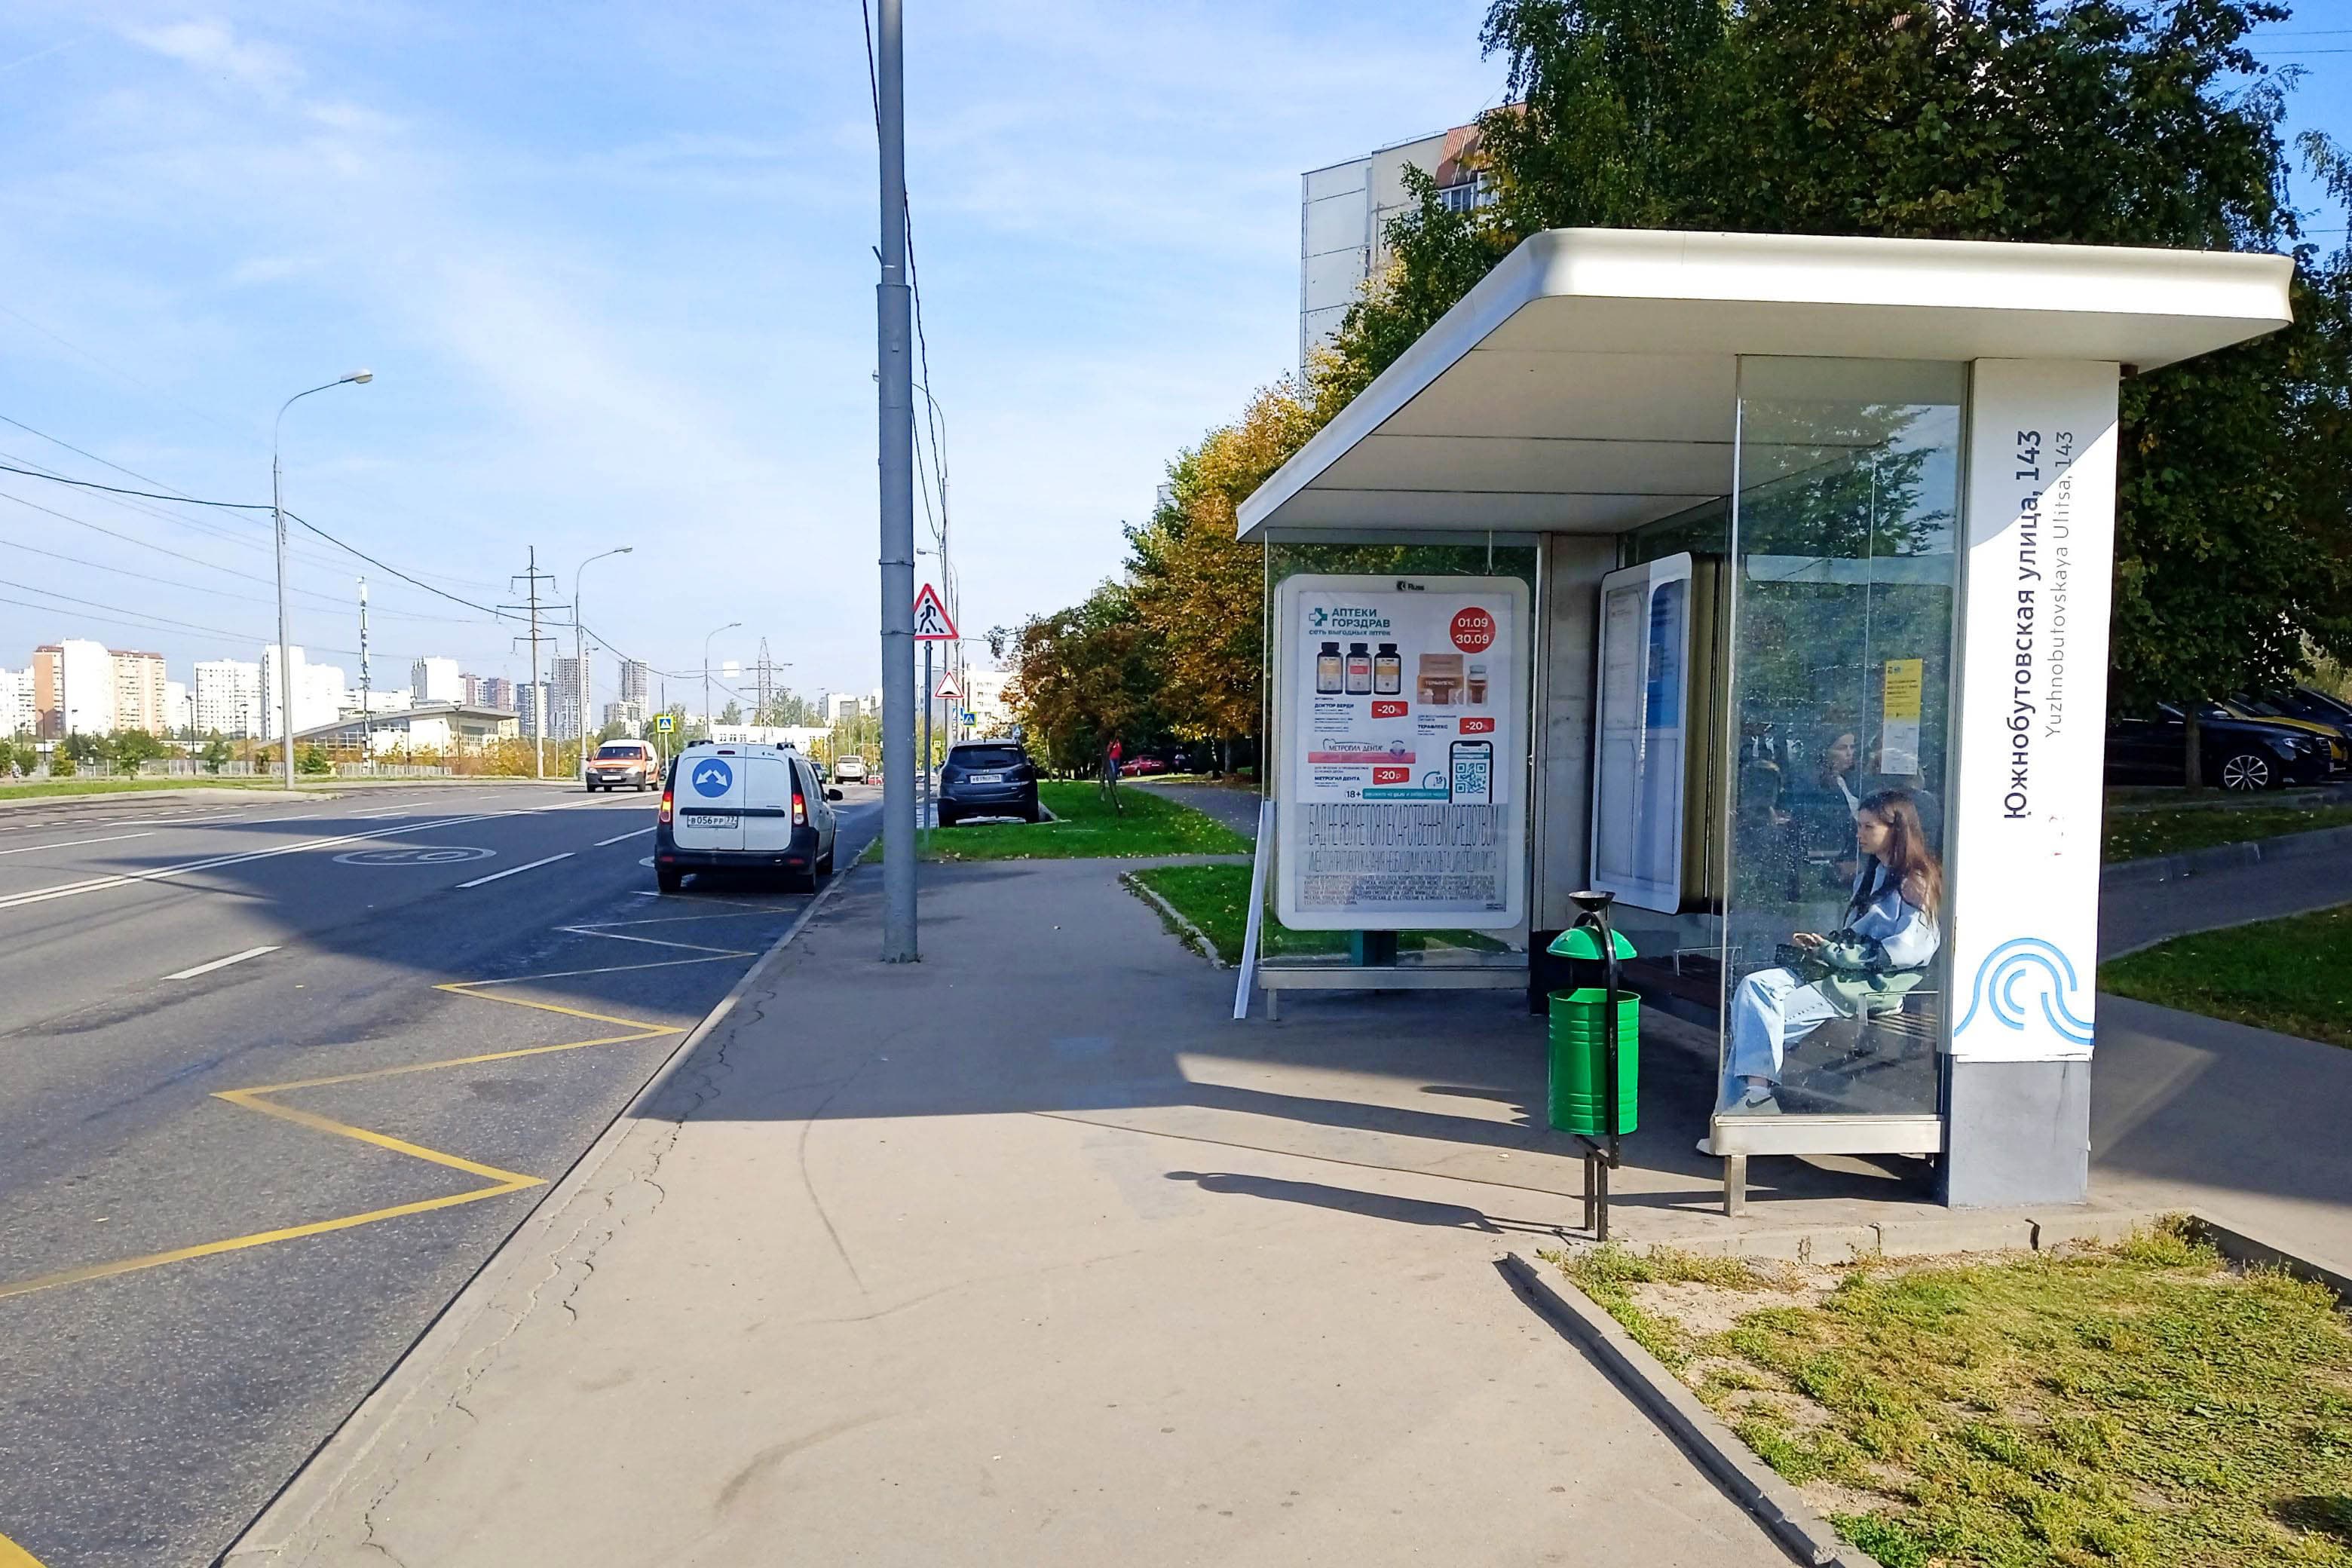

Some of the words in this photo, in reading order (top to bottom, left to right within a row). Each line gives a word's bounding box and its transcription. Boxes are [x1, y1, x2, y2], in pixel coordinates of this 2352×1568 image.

[2016, 430, 2041, 481] 143
[2055, 432, 2073, 467] 143
[2052, 476, 2072, 538] Ulitsa,
[2018, 491, 2043, 581] улица,
[1331, 608, 1377, 617] АПТЕКИ
[1331, 619, 1391, 629] ГОРЗДРАВ
[1457, 617, 1489, 627] 01.09
[1455, 635, 1490, 644] 30.09
[2044, 547, 2072, 737] Yuzhnobutovskaya
[2004, 590, 2036, 818] Южнобутовская
